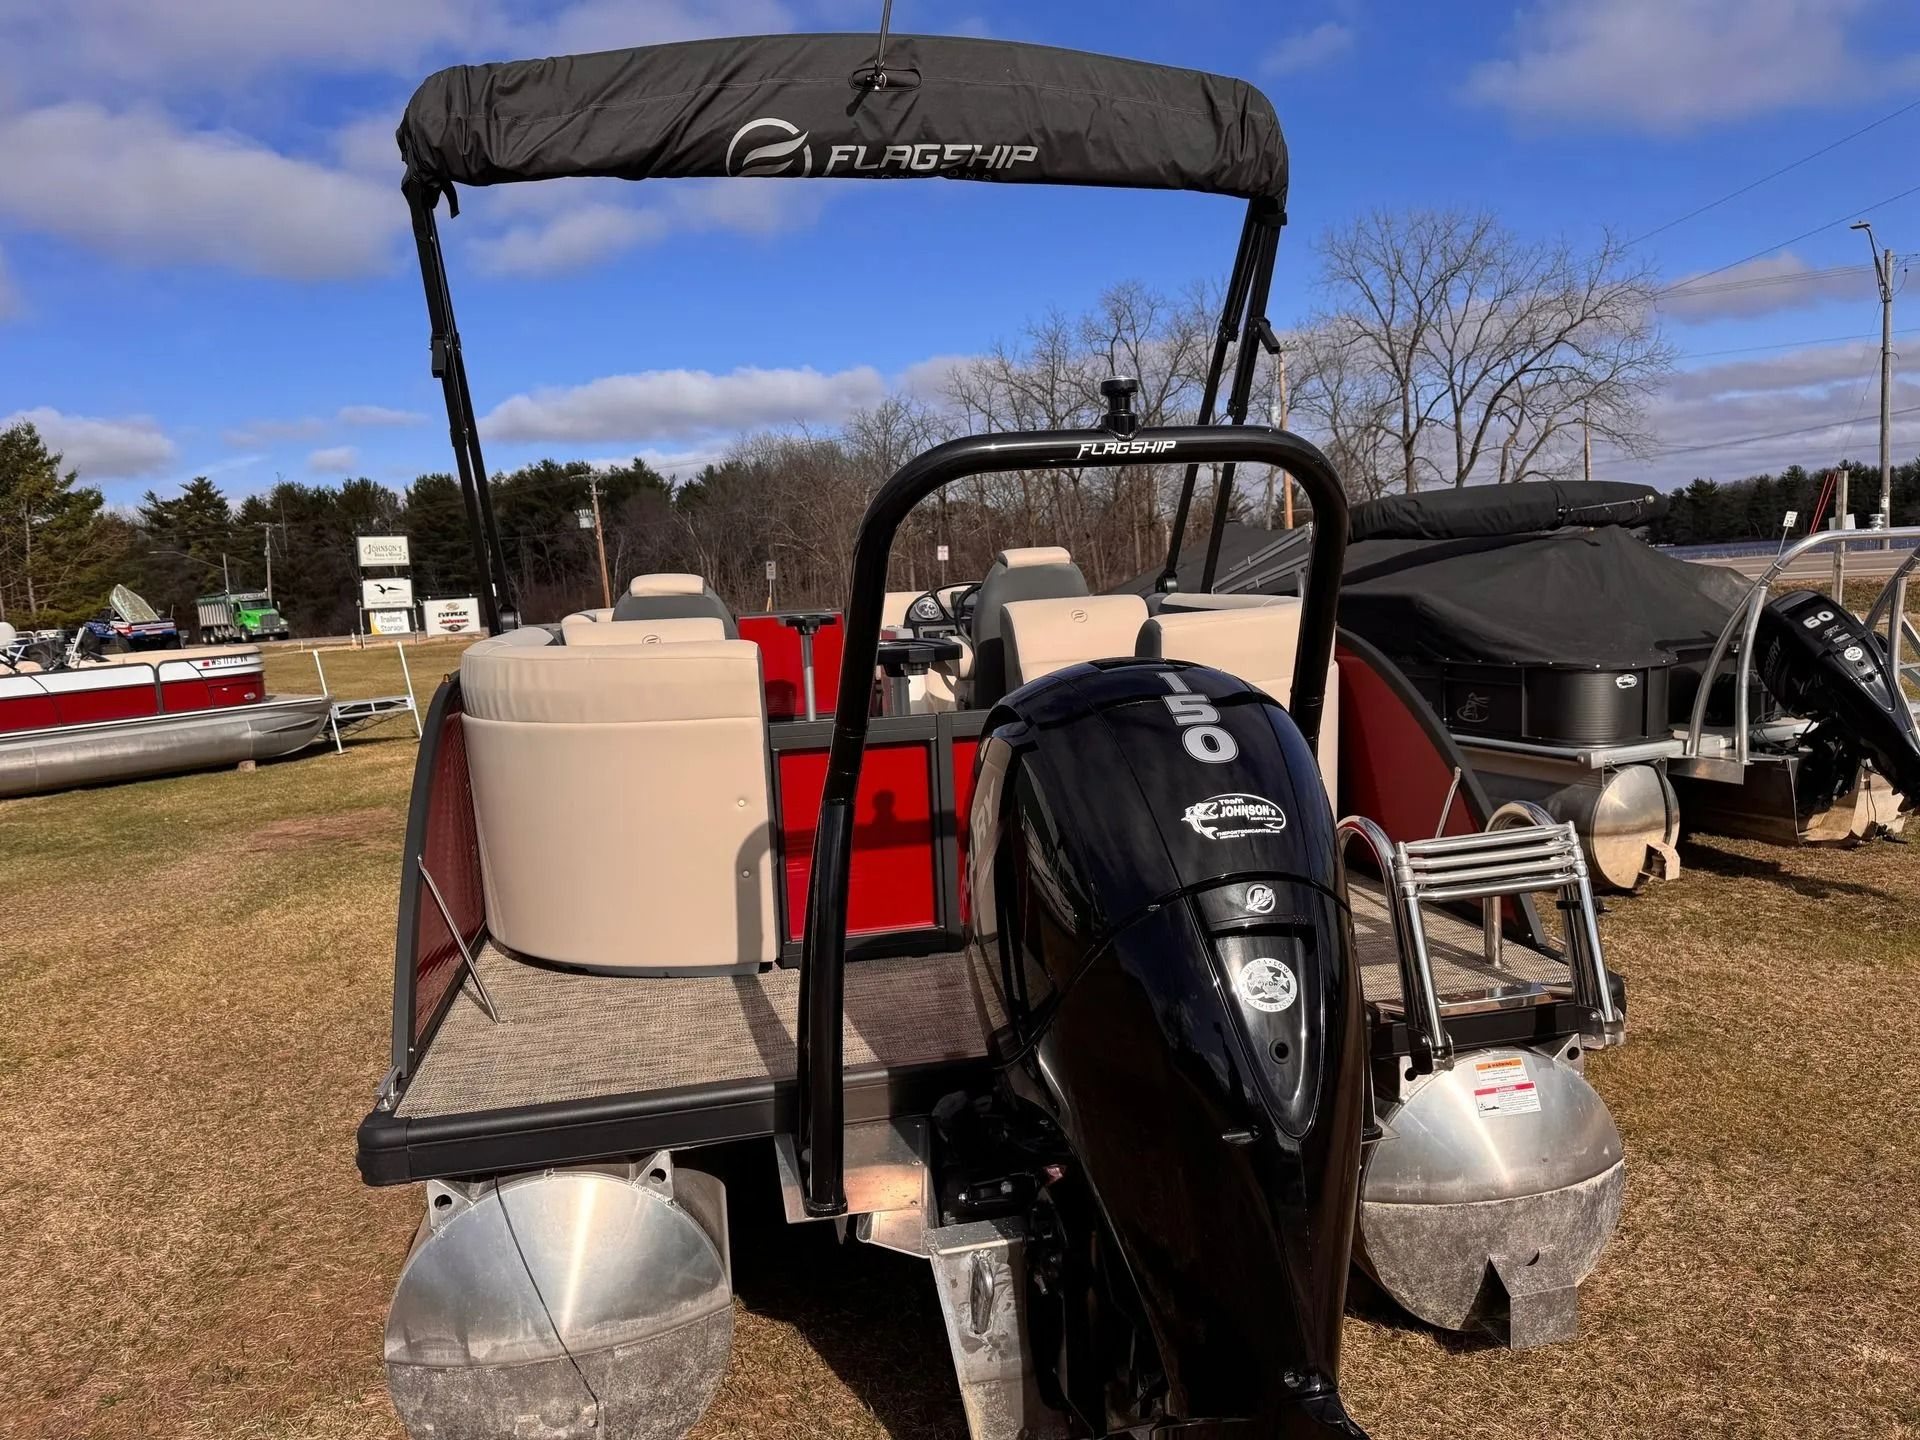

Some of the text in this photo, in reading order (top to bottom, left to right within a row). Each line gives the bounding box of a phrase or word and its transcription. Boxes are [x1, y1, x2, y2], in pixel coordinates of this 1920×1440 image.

[822, 143, 1039, 177] FLAGSHIP
[1076, 440, 1177, 460] FLAGSHIP
[1802, 610, 1835, 629] 60
[1154, 671, 1240, 765] 150
